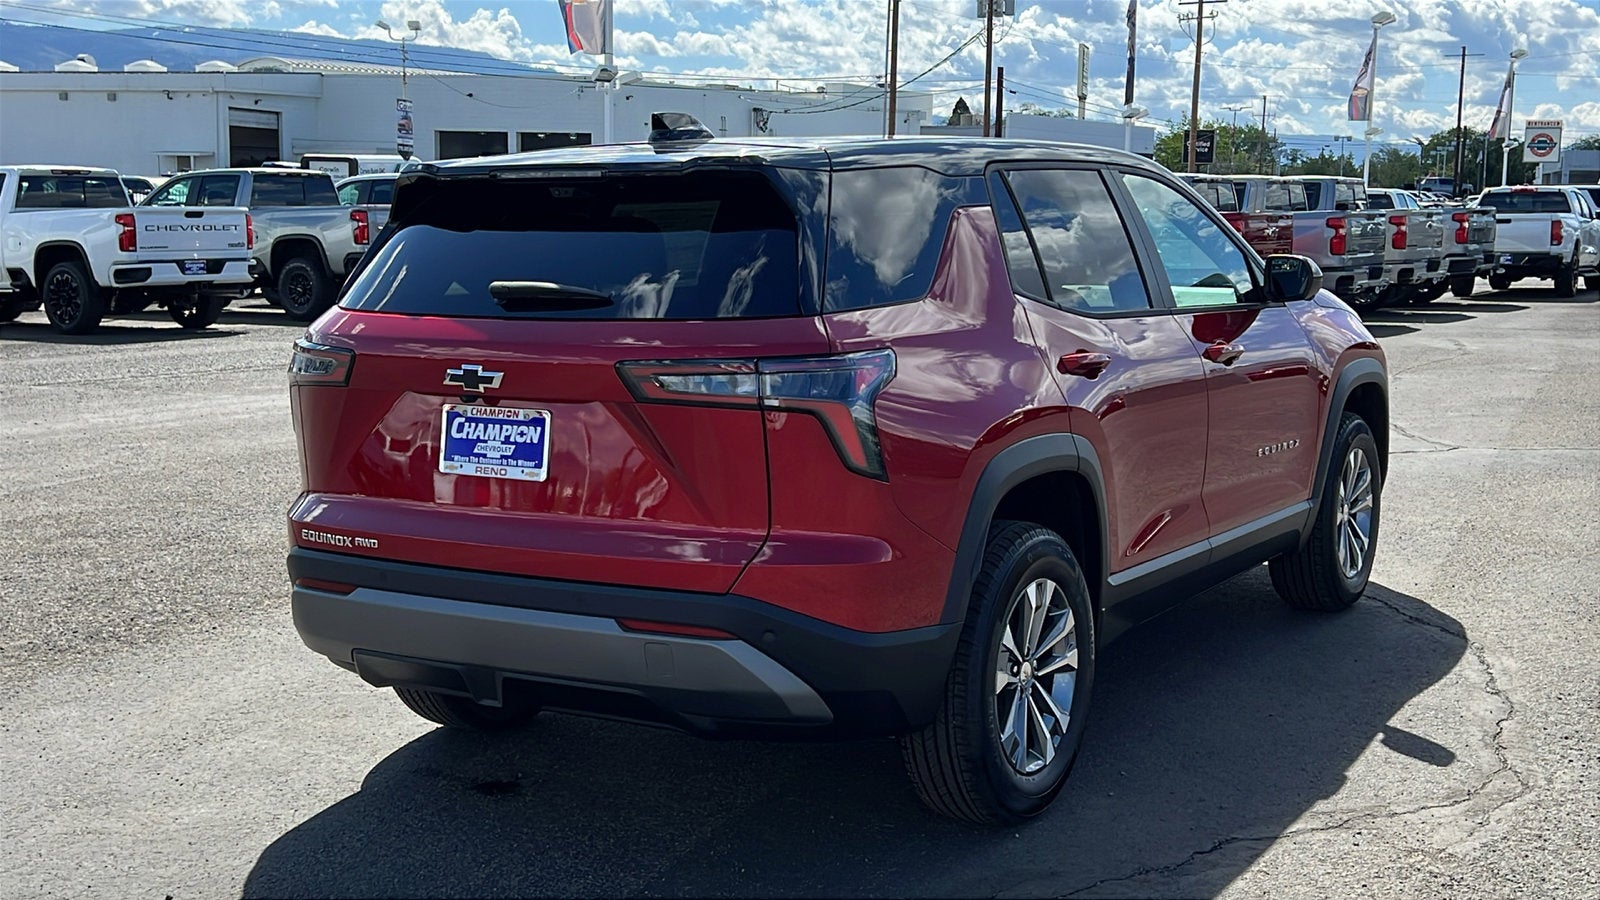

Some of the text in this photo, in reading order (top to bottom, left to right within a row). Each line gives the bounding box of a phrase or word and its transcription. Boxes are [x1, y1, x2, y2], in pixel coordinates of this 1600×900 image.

[145, 224, 240, 232] CHEVROLET
[470, 407, 520, 418] CHAMPION
[450, 417, 541, 444] CHAMPION
[476, 445, 512, 453] CHEVROLET
[1257, 439, 1300, 457] EQUINOX
[475, 466, 507, 476] RENO
[301, 529, 378, 548] EQUINOX AWD
